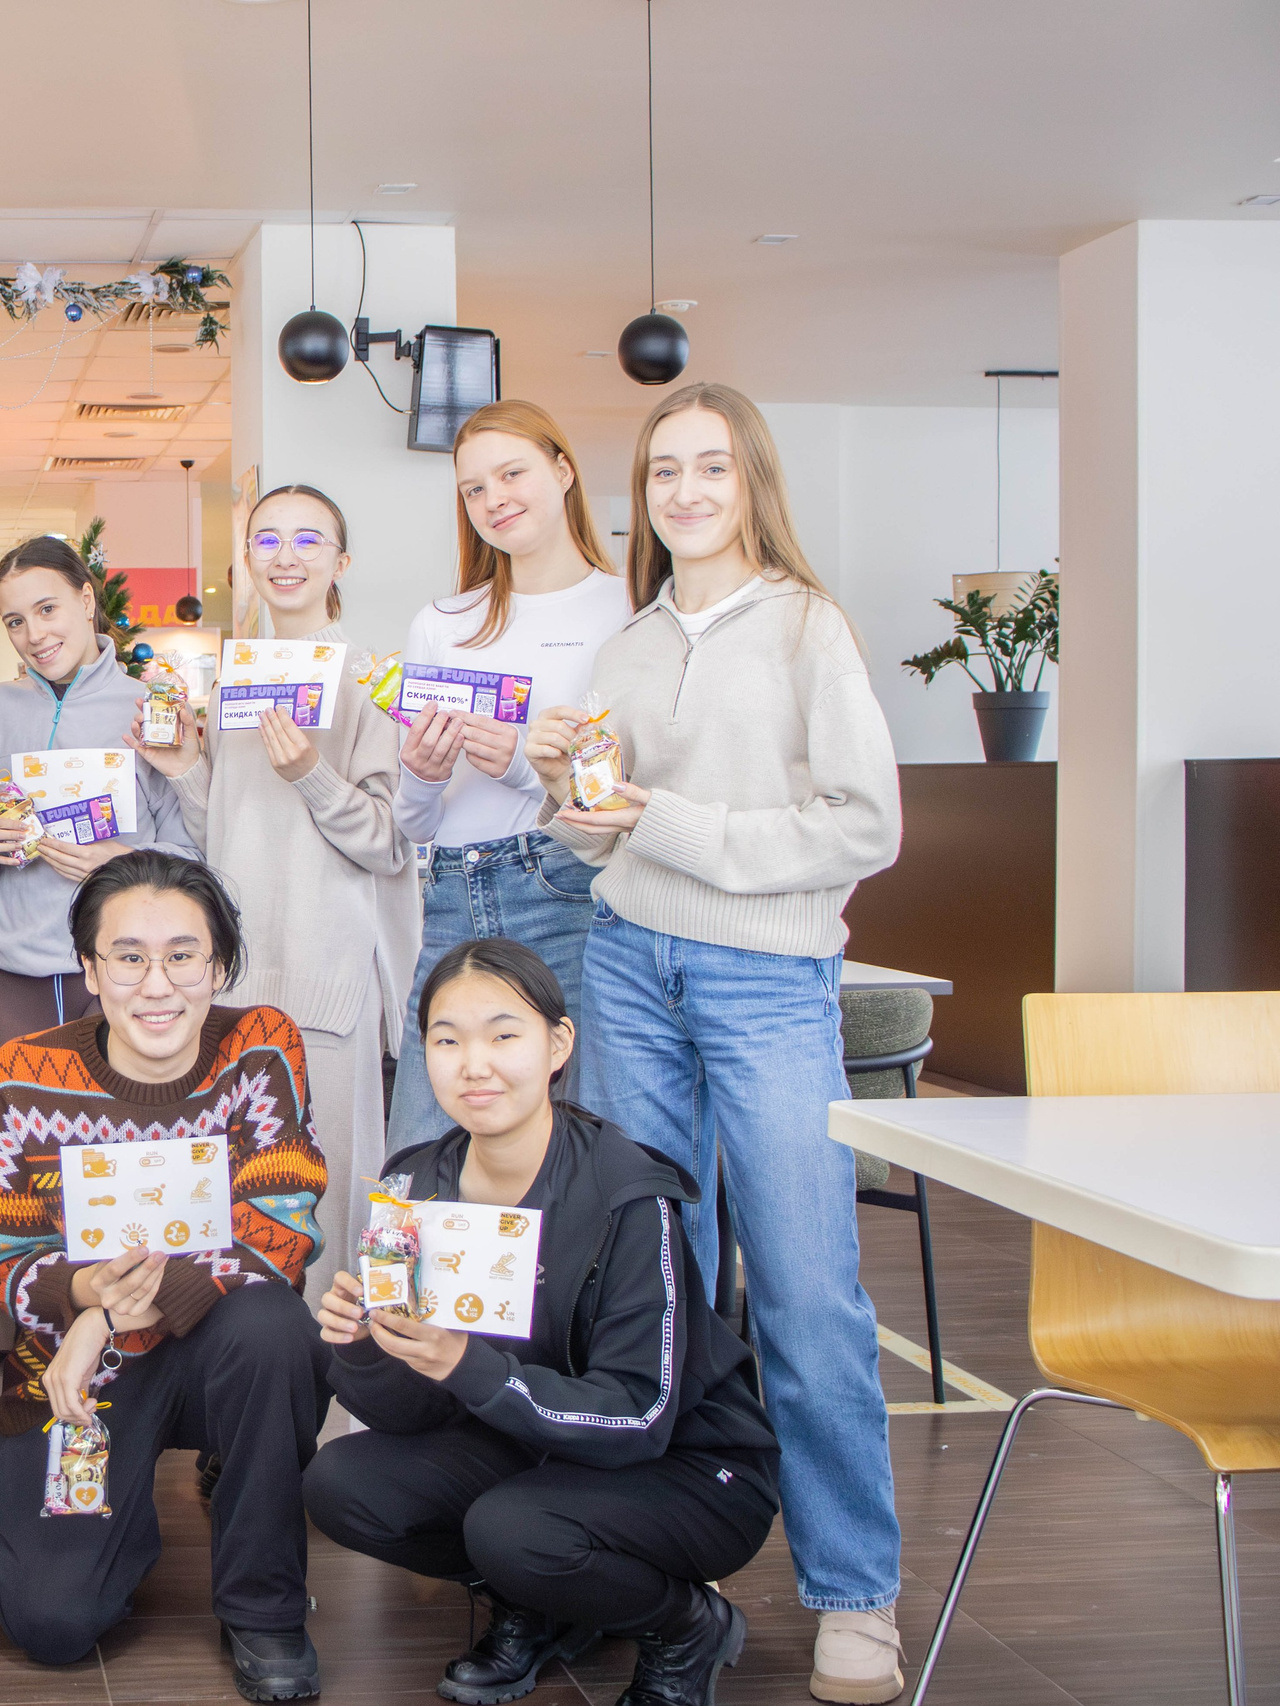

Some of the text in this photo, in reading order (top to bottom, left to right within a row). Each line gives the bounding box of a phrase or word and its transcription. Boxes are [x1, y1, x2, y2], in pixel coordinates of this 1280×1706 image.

[405, 664, 439, 680] TEA
[221, 685, 297, 699] TEA FUNNY
[406, 691, 445, 702] СКИДКА
[224, 711, 253, 719] СКИДКА
[45, 801, 88, 822] FUNNY
